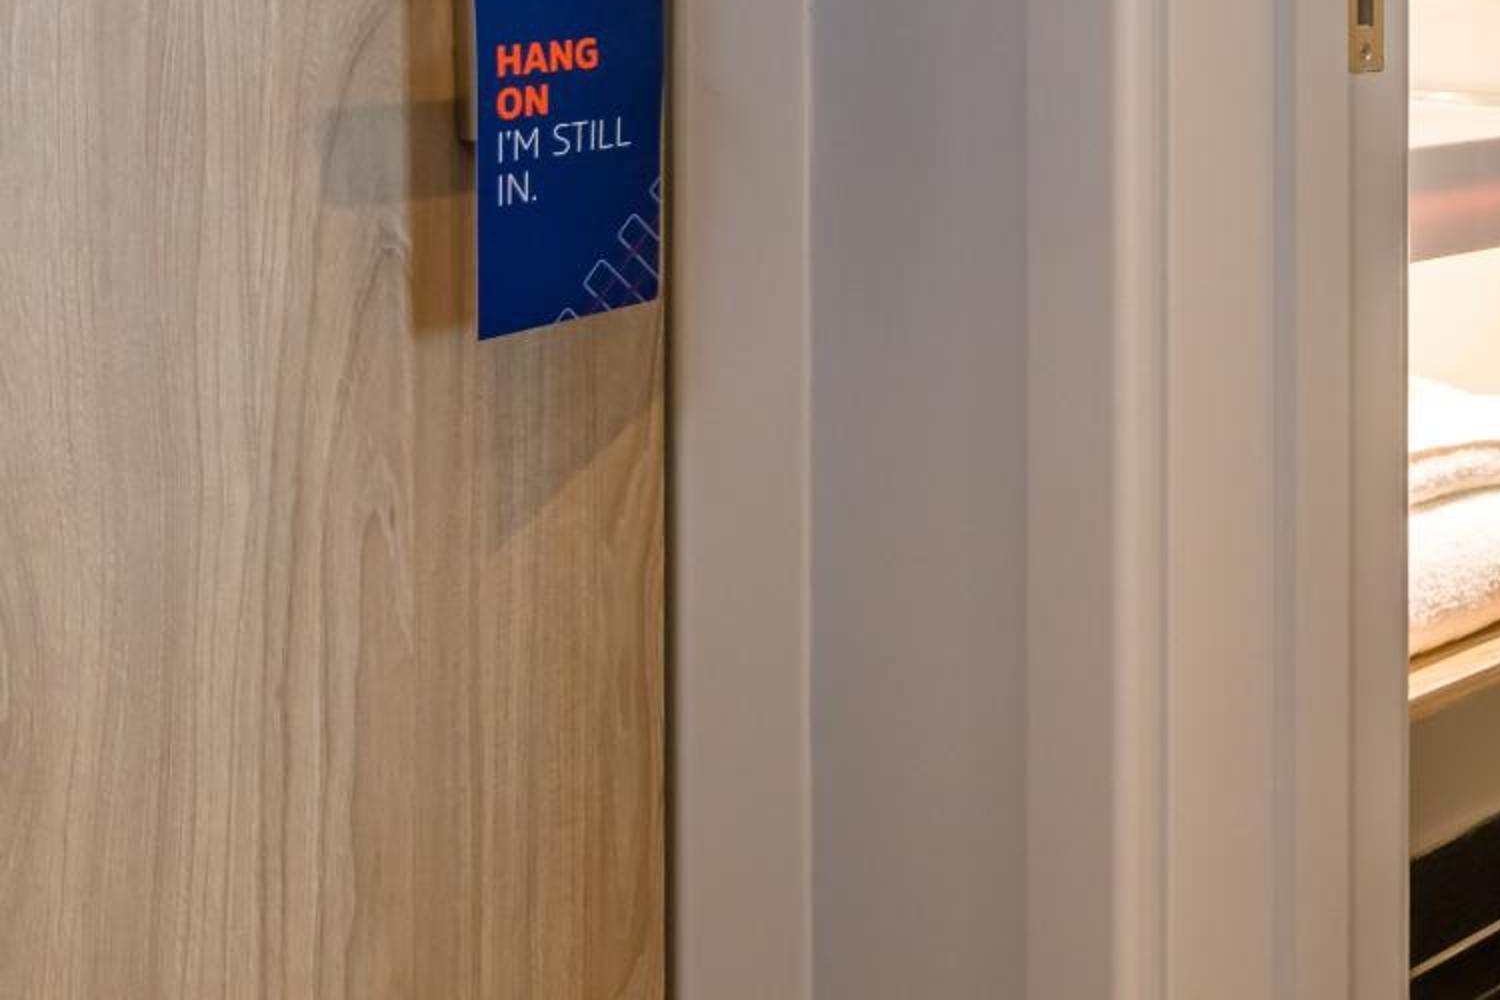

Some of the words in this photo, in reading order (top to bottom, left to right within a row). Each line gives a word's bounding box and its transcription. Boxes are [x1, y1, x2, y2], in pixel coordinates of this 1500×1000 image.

[496, 37, 599, 78] HANG
[496, 83, 549, 120] ON
[498, 126, 540, 163] I'M
[552, 116, 632, 156] STILL
[498, 170, 537, 207] IN.
